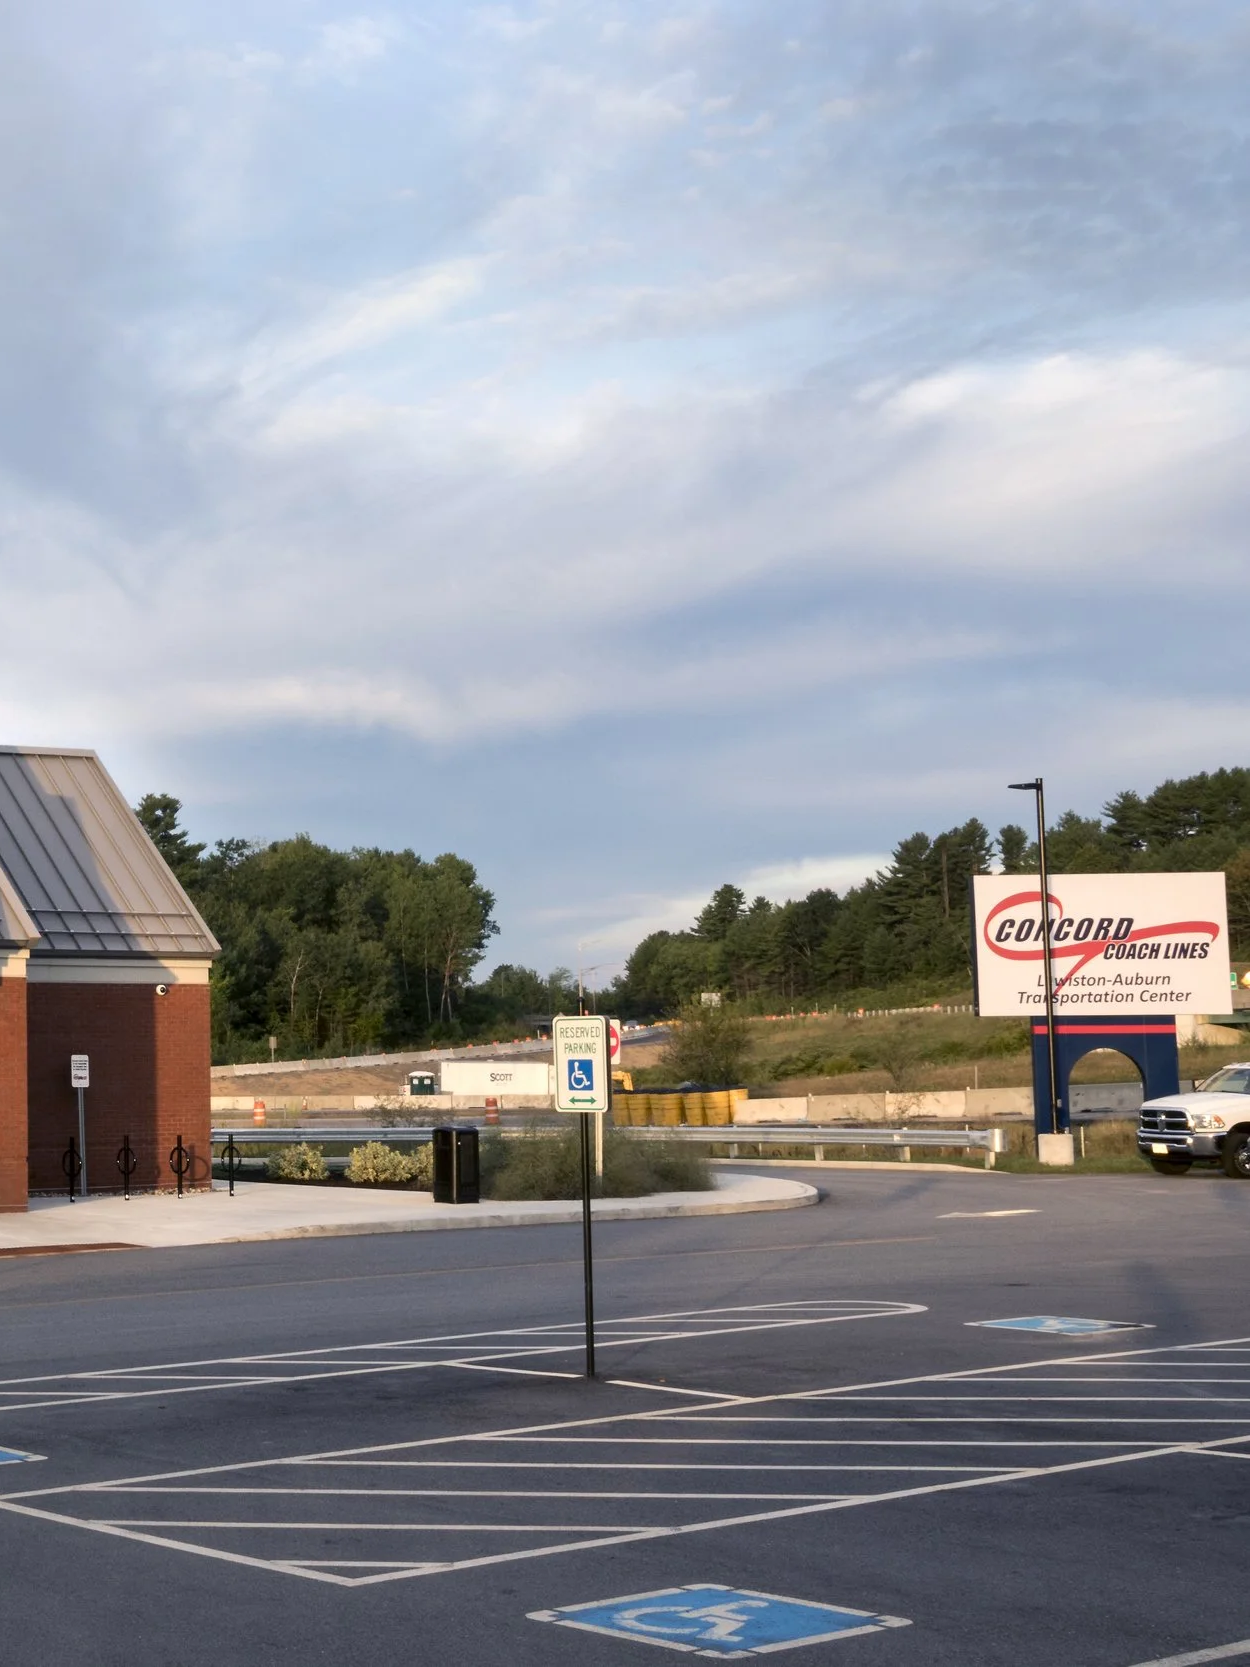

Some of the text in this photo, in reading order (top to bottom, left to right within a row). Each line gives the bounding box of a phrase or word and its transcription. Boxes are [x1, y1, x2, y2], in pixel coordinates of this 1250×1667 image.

[995, 917, 1134, 942] CONCORD
[1103, 942, 1210, 960] COACH LINES
[1037, 973, 1171, 987] Lwiston-Auburn
[1139, 989, 1192, 1003] Center
[559, 1026, 601, 1038] RESERVED
[564, 1042, 597, 1054] PARKING
[490, 1072, 513, 1082] SCOTT
